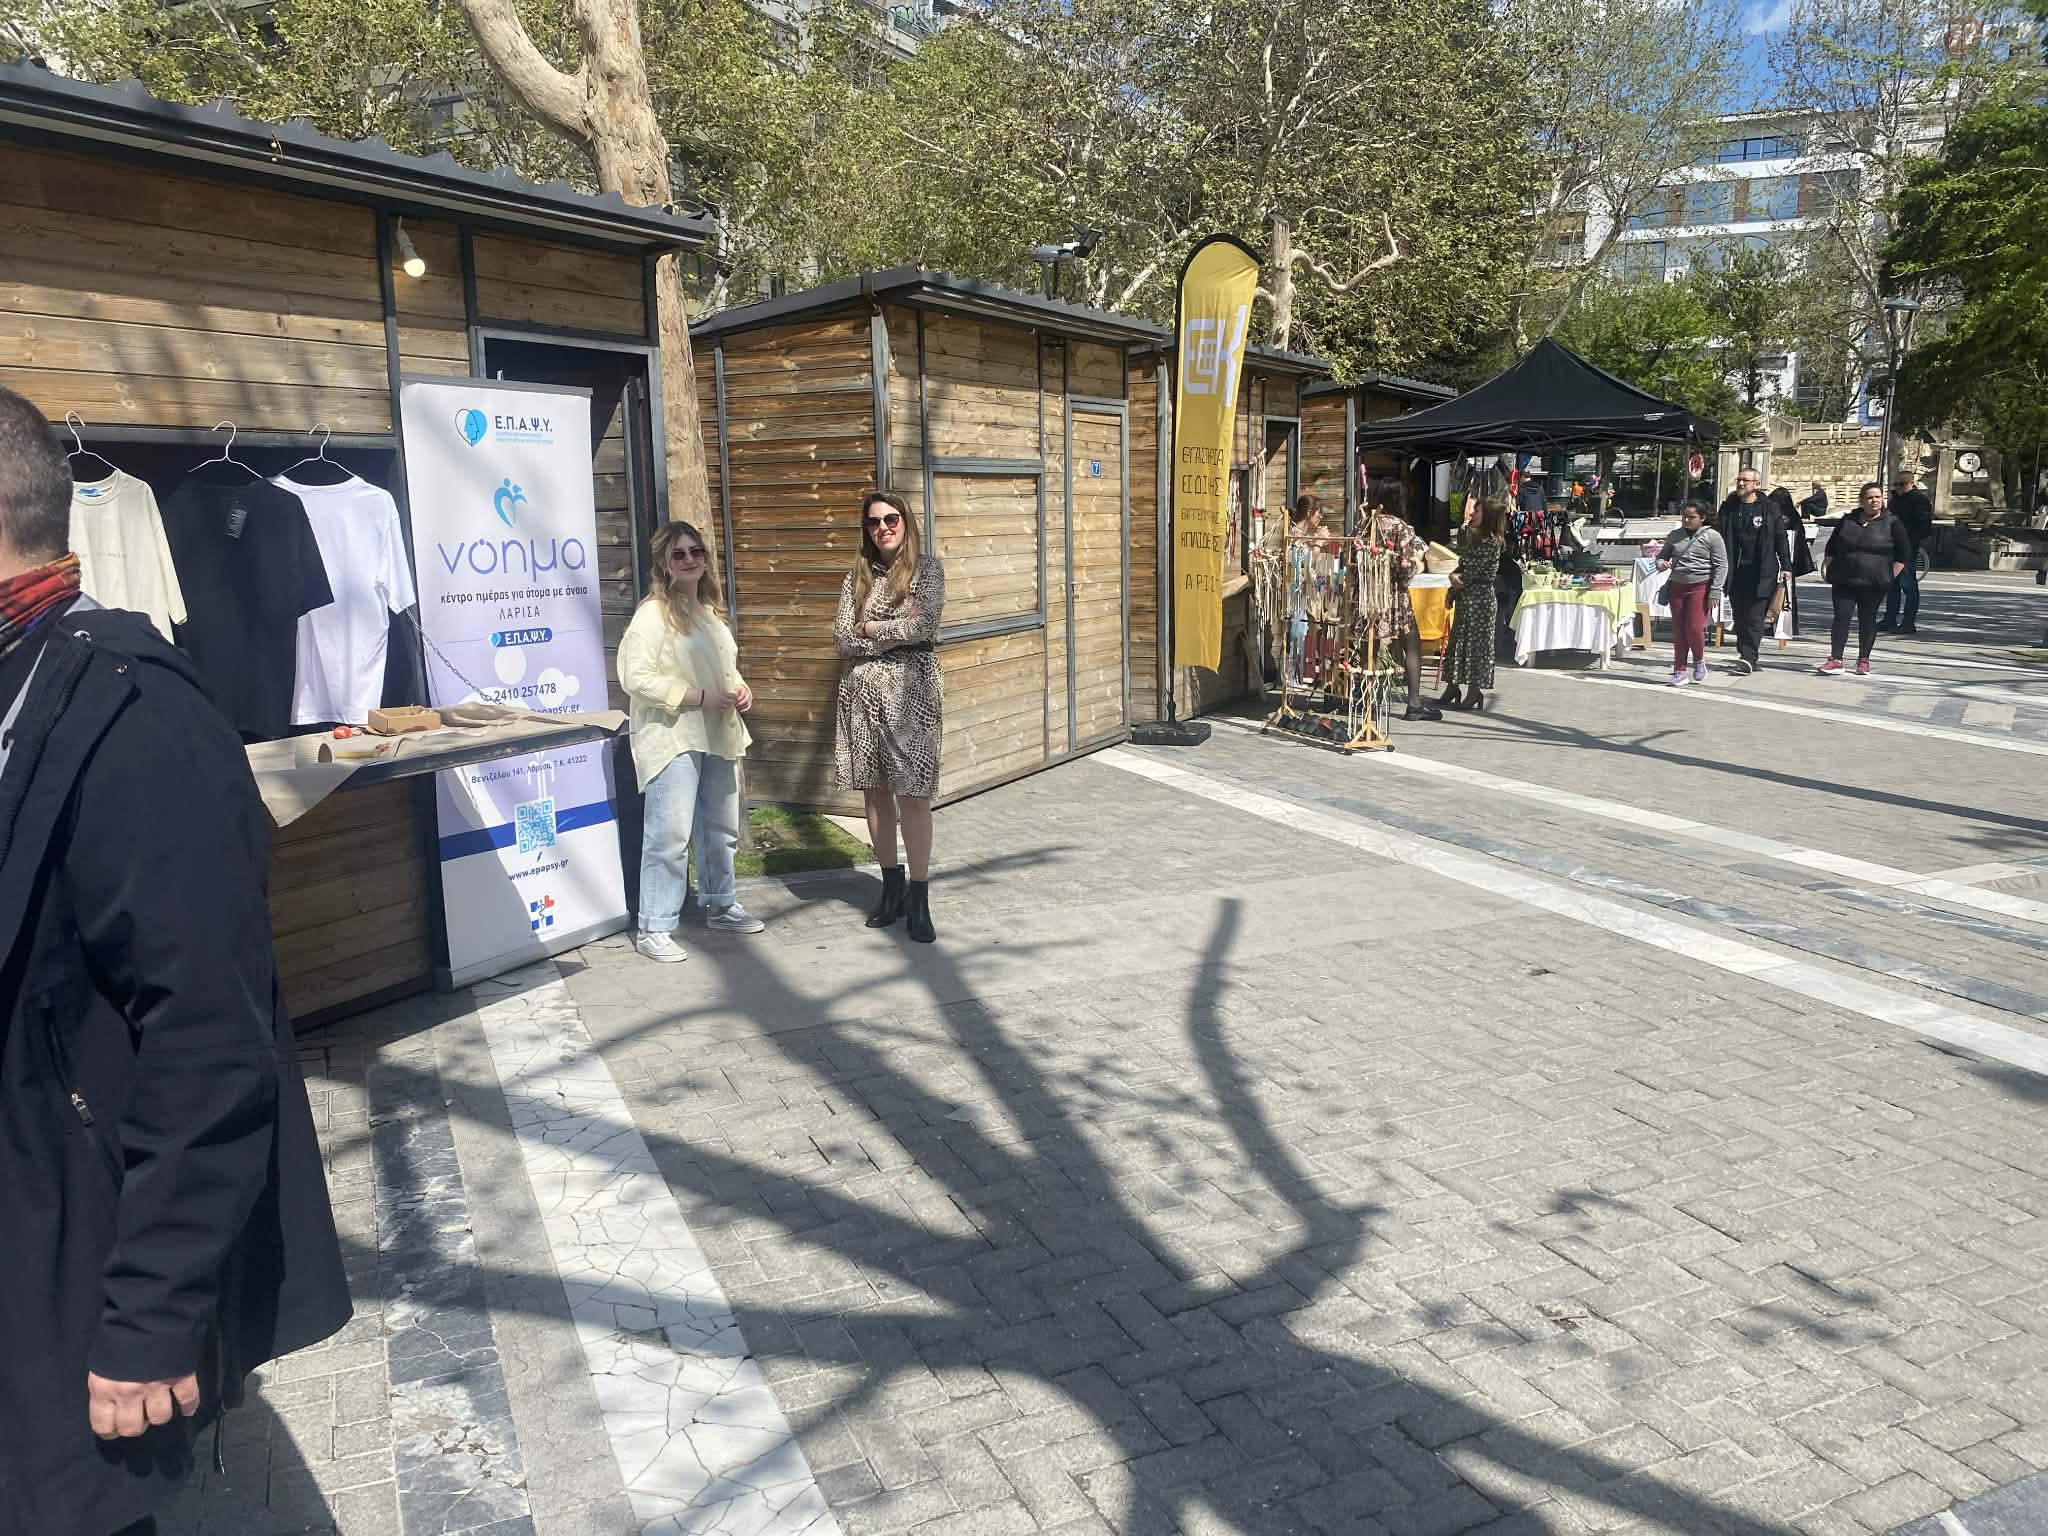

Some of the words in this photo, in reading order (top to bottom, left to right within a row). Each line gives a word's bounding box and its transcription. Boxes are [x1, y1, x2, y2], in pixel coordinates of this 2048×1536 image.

[495, 415, 553, 432] Ε.Π.Α.Ψ.Υ.
[440, 592, 473, 605] κέντρο
[475, 589, 510, 604] ημέρας
[511, 591, 525, 602] για
[526, 586, 551, 600] άτομα
[552, 588, 564, 600] με
[565, 583, 588, 596] άνοια
[499, 605, 541, 621] ΛΑΡΙΣΑ
[505, 630, 549, 645] Ε.Π.Α.Ψ.Υ.
[494, 688, 519, 701] 2410
[521, 682, 557, 698] 257478
[471, 769, 511, 784] Βενιζέλου
[508, 859, 569, 881] www.epapsy.gr
